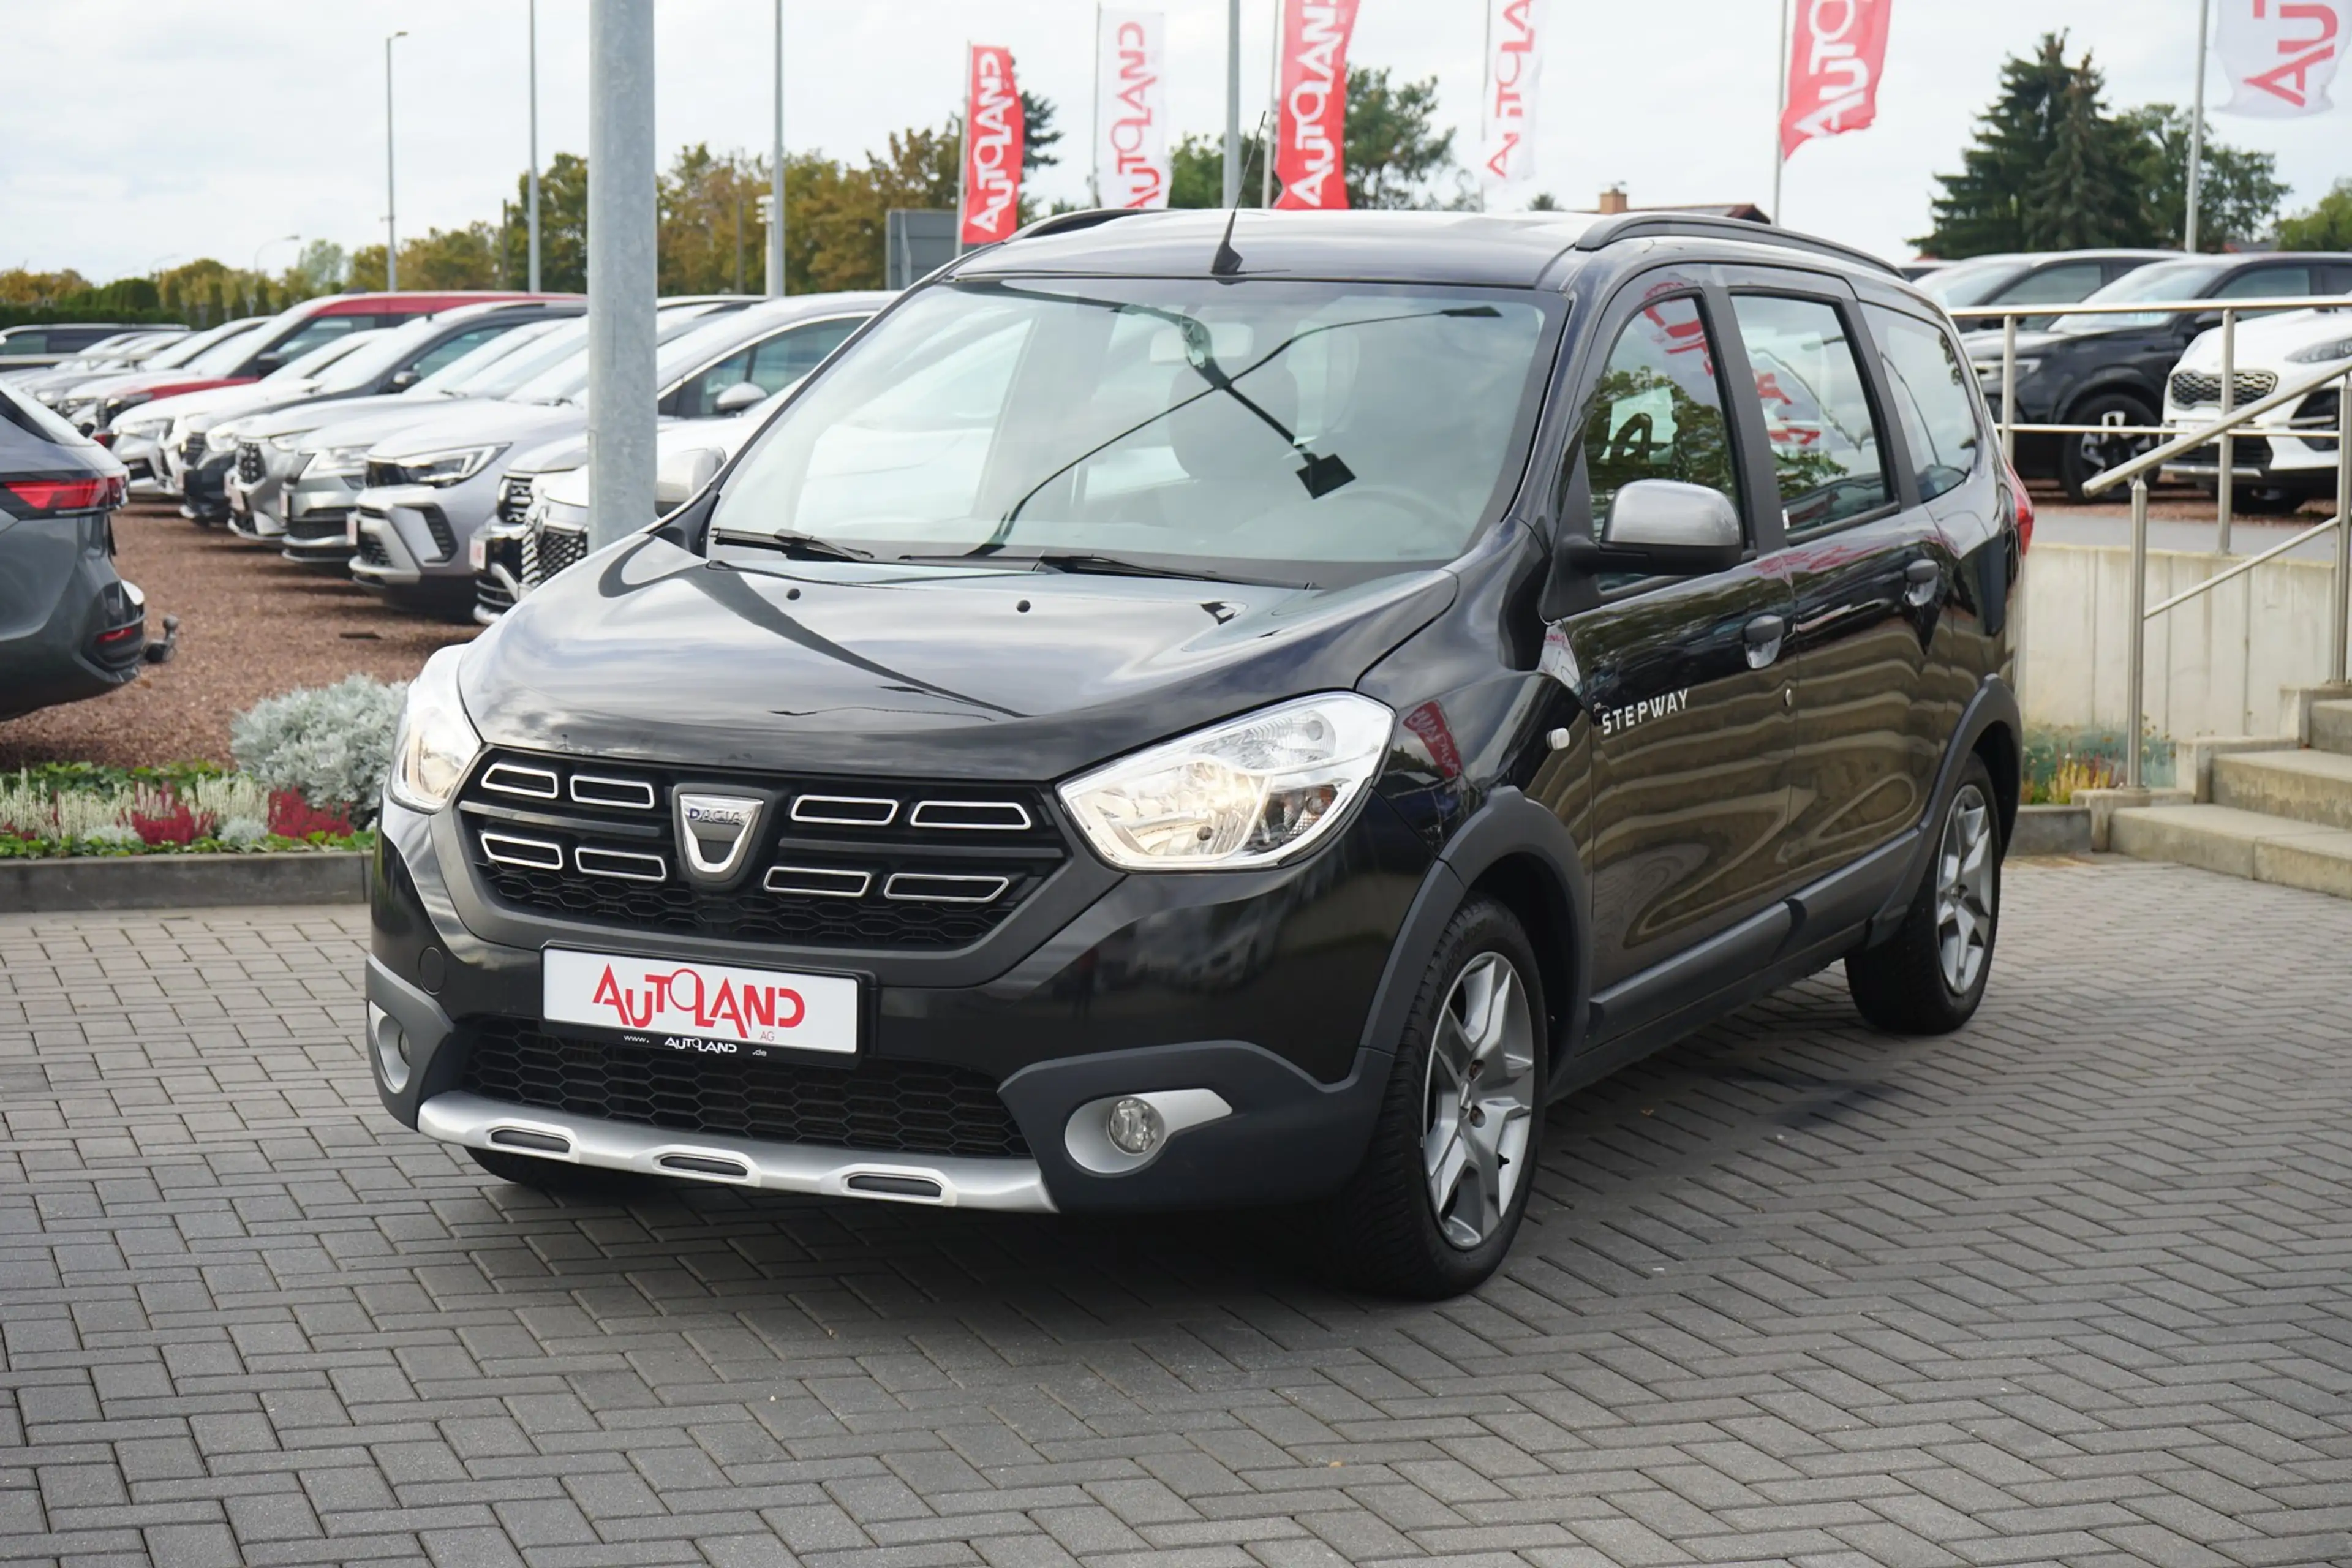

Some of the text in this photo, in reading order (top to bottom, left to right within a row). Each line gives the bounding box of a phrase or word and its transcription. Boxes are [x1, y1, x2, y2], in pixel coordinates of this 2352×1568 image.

[1289, 0, 1343, 207] AUTOLAN
[970, 51, 1015, 233] AUTOLAND
[1602, 688, 1689, 736] STEPWAY
[689, 807, 747, 826] DACIA
[592, 963, 805, 1039] AUTOLAND
[623, 1035, 767, 1057] www. AUTOLAND .de
[760, 1031, 775, 1042] AG
